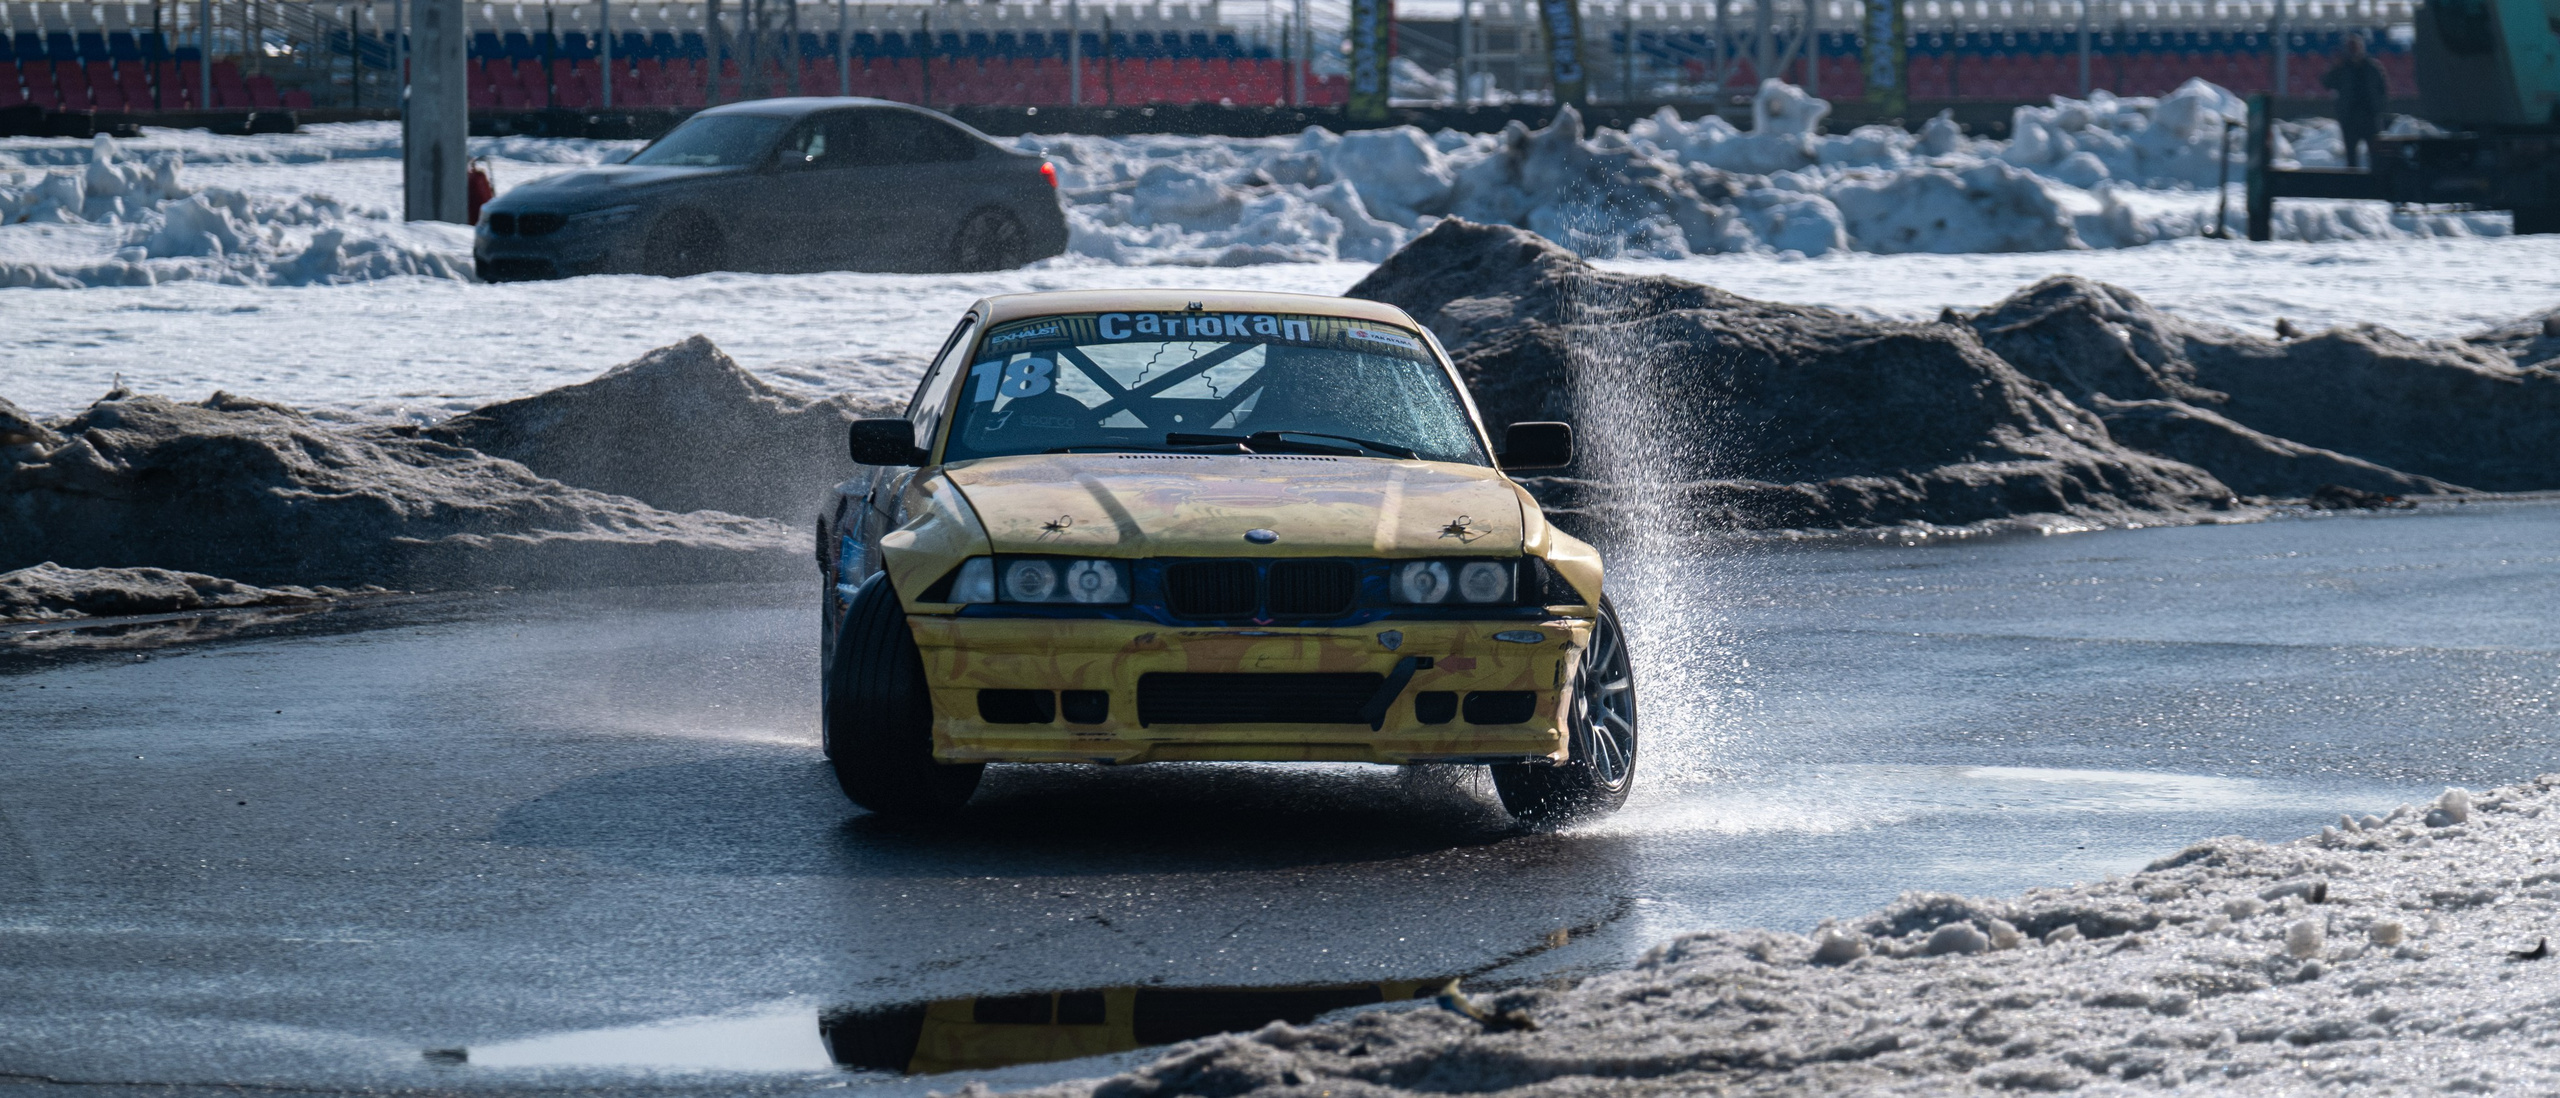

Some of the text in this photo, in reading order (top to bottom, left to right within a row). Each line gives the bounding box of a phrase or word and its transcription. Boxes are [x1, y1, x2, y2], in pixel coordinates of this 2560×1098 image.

[991, 326, 1059, 344] EXHAUST
[1371, 334, 1412, 346] TAKAYAMA
[971, 357, 1054, 403] 18
